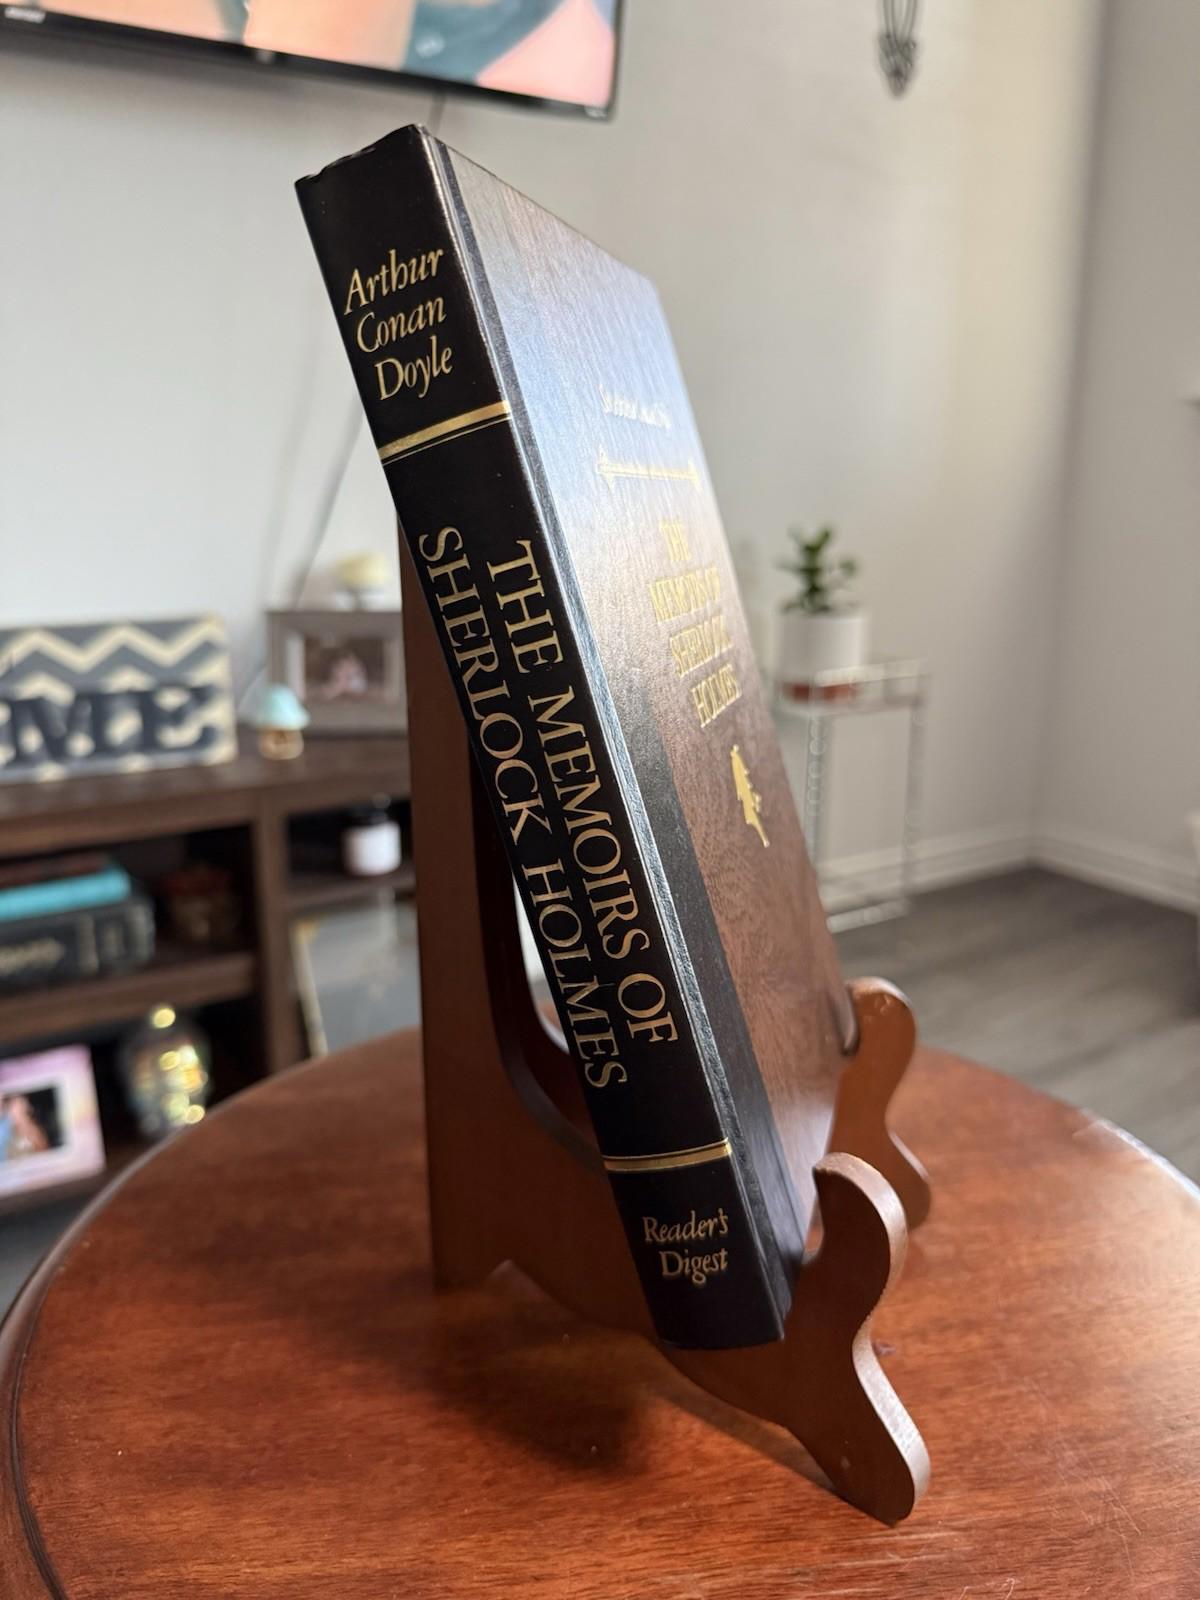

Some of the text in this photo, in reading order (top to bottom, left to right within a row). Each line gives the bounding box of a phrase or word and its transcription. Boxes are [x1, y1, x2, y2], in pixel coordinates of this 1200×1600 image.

[344, 248, 444, 315] Arthur
[357, 296, 447, 353] Conan
[374, 335, 453, 401] Doyle
[418, 526, 628, 1088] SHERLOCK HOLMES
[487, 538, 679, 1043] THE MEMOIRS OF
[642, 1207, 729, 1243] Reader's
[659, 1247, 728, 1286] Digest
